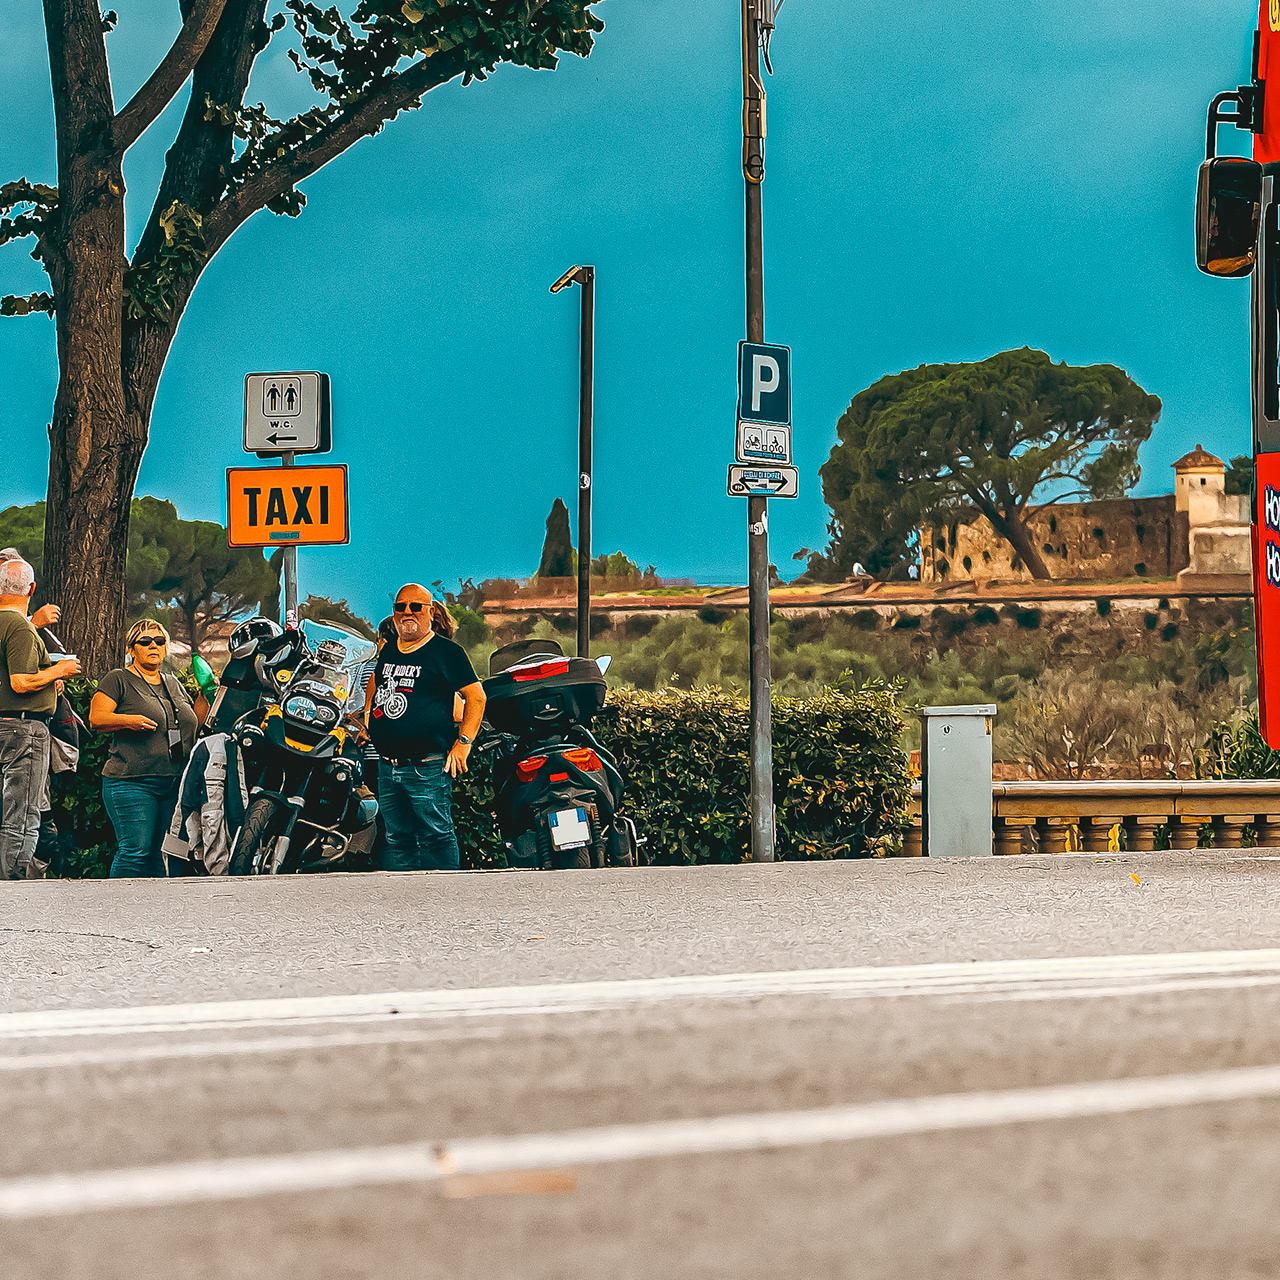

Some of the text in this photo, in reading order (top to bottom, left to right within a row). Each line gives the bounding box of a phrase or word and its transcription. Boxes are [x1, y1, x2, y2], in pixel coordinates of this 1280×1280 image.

[752, 354, 780, 412] P
[269, 420, 294, 428] W.C.
[243, 485, 329, 527] TAXI
